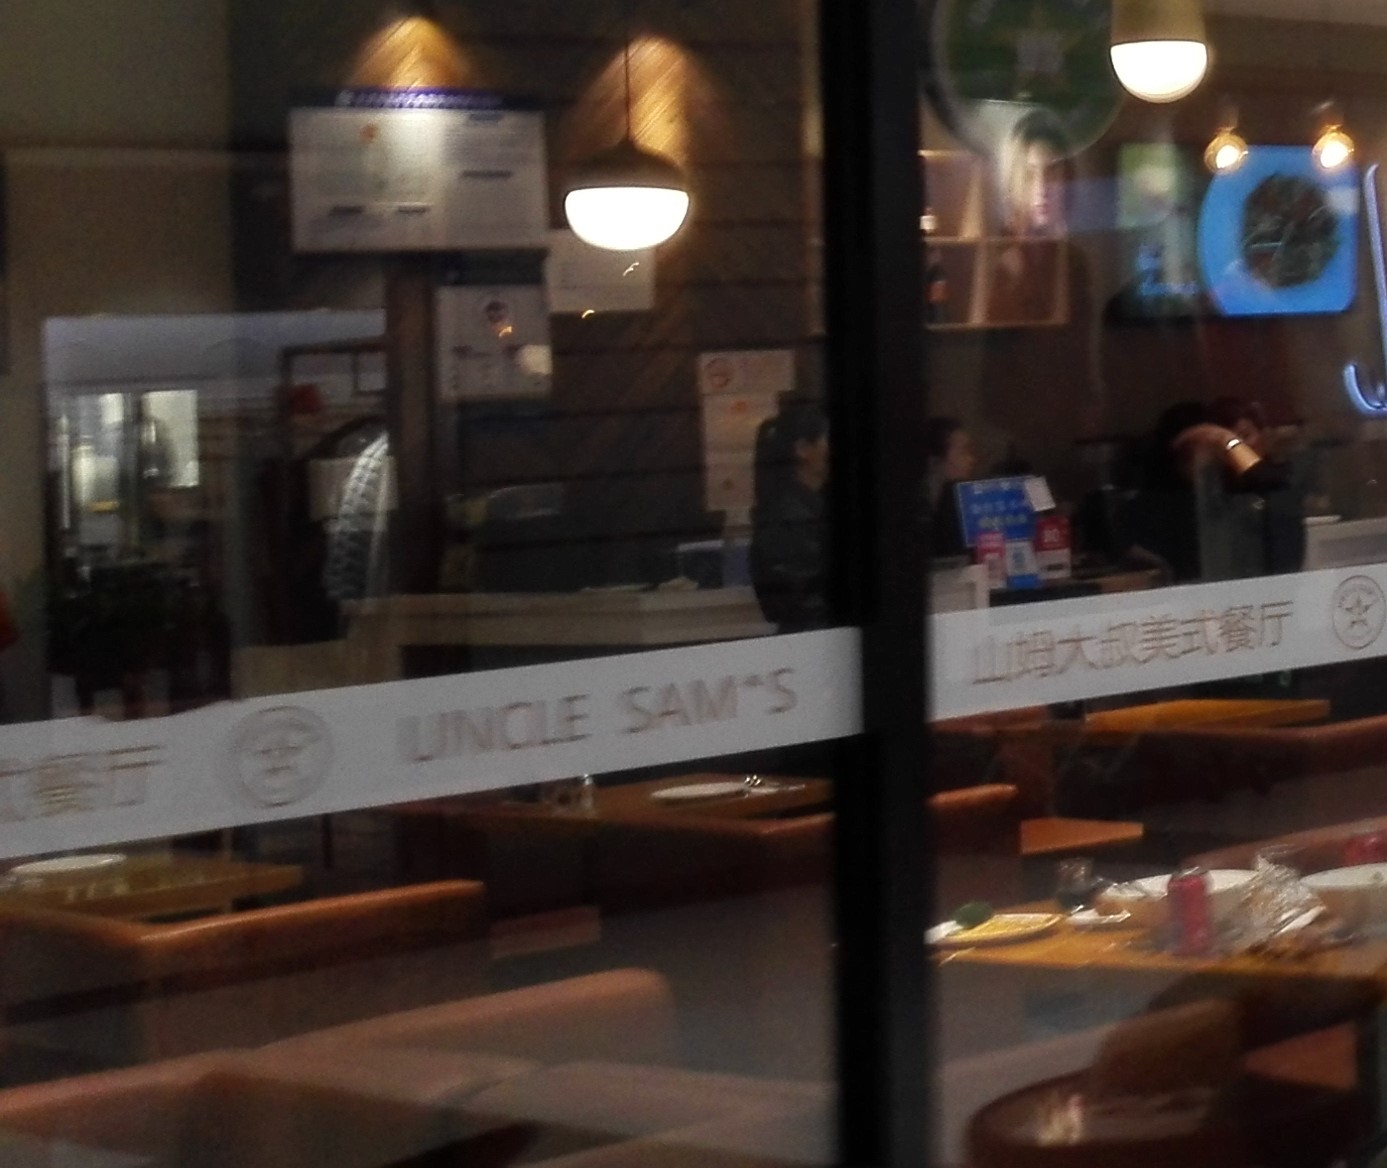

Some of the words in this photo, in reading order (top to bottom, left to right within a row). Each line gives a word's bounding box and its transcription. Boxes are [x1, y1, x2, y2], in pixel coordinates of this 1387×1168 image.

[972, 599, 1294, 685] 山姆大叔美式餐厅
[405, 693, 590, 764] UNCLE
